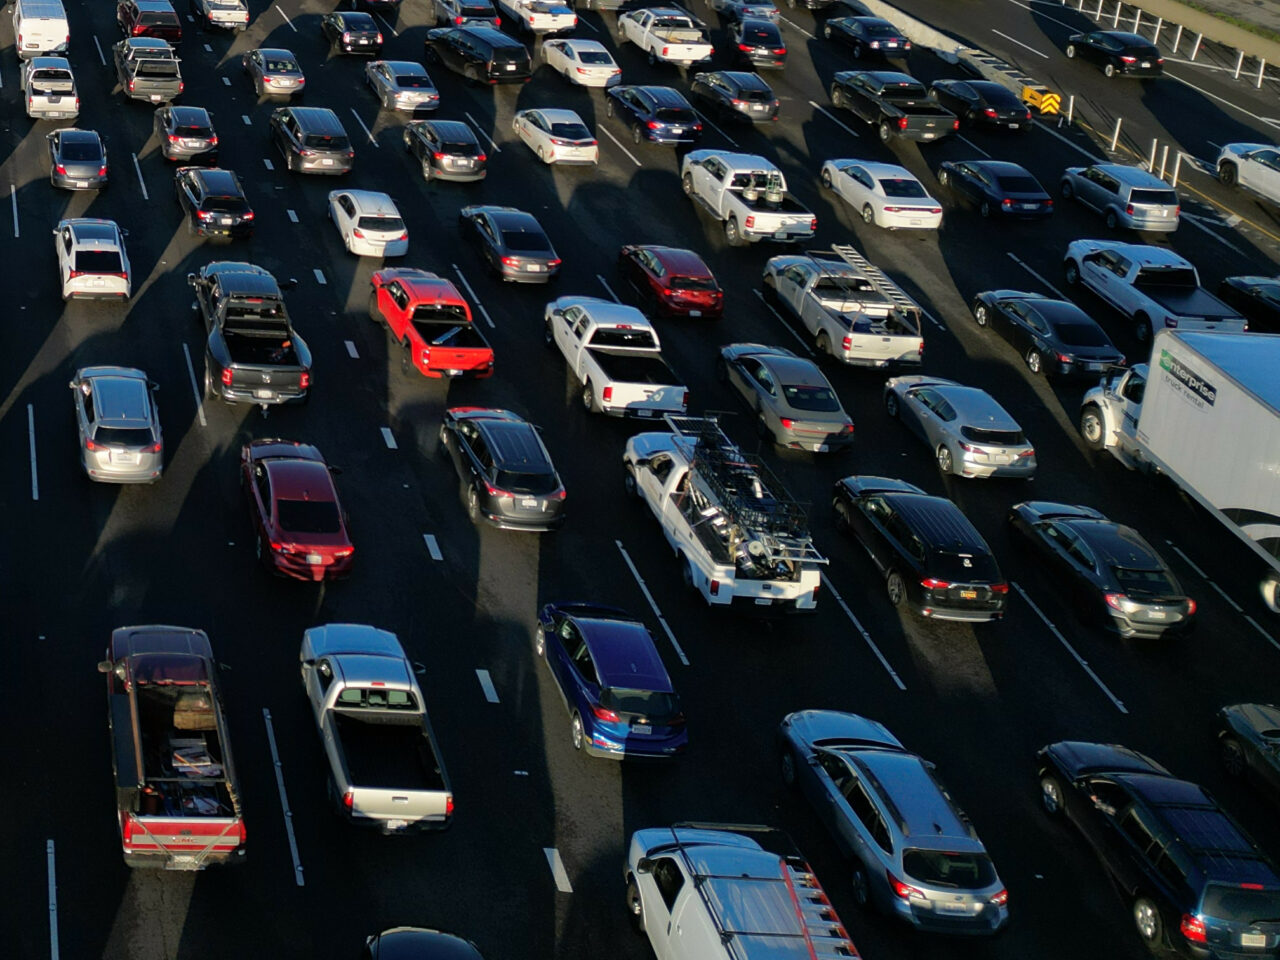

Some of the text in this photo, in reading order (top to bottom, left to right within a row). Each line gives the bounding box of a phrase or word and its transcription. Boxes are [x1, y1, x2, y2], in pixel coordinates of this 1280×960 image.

[1161, 357, 1215, 401] enterprise
[1165, 375, 1205, 409] truck rental
